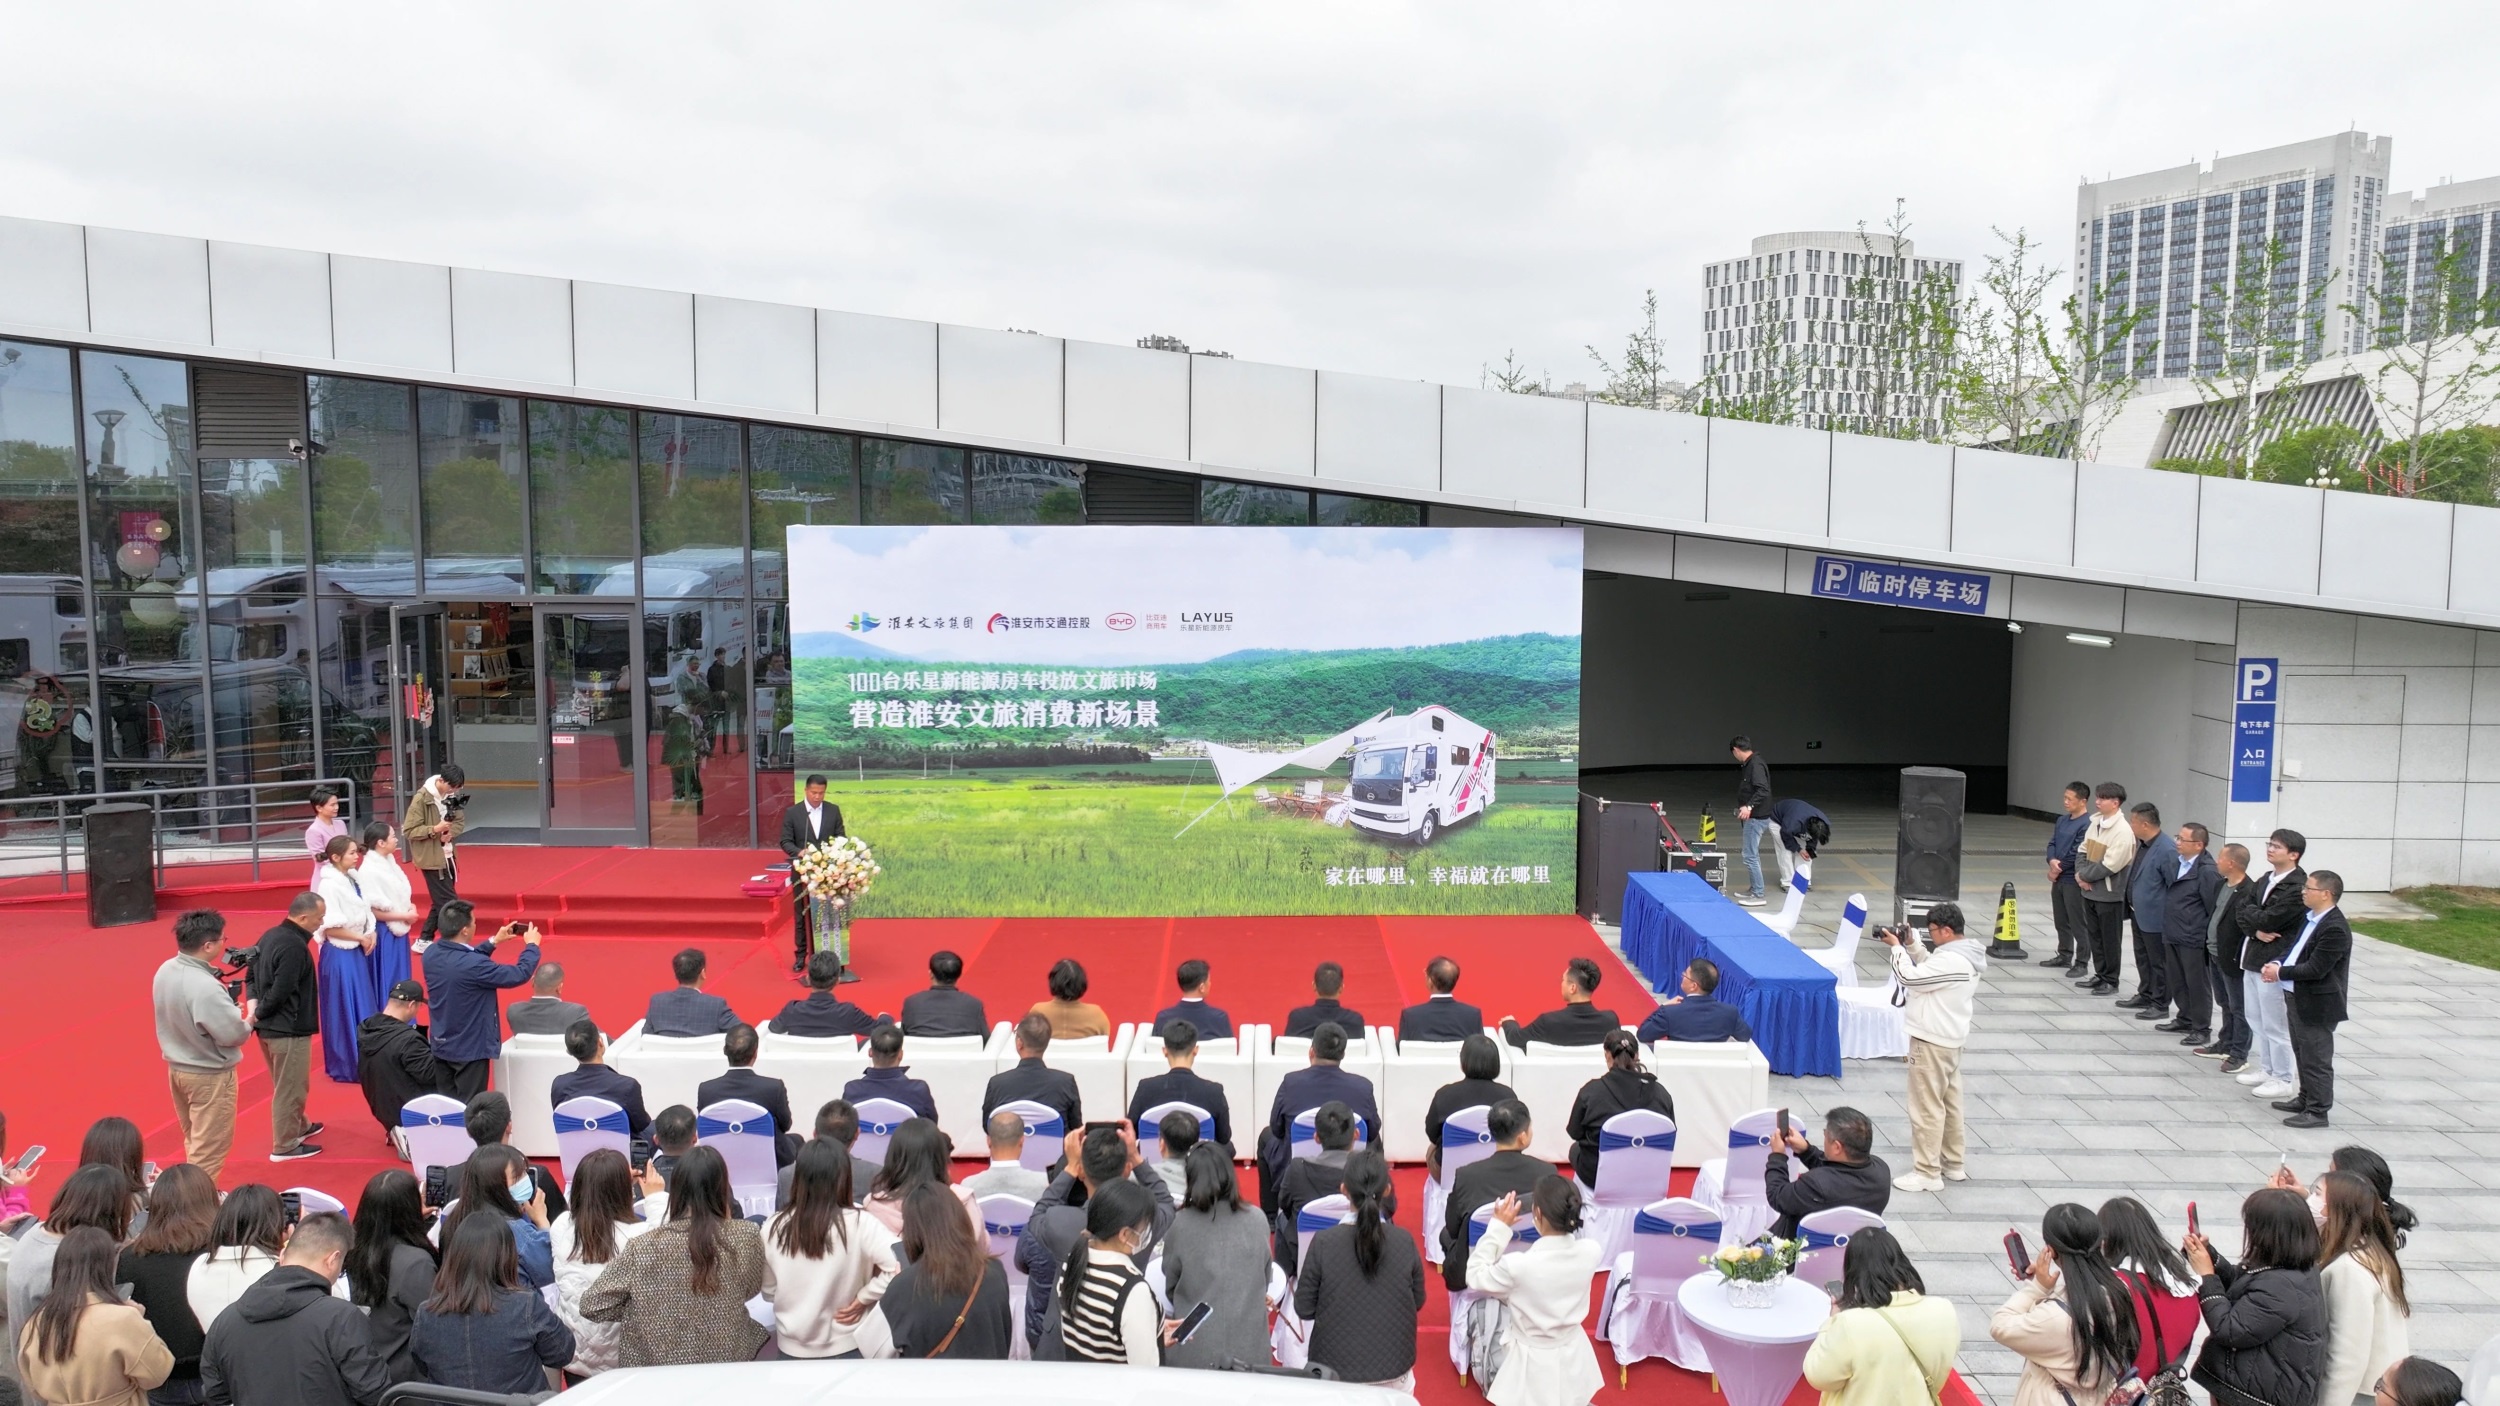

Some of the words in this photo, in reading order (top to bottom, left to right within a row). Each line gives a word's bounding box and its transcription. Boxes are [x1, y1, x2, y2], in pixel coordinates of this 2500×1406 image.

[1858, 570, 1982, 606] 临时停车场
[1011, 617, 1090, 629] 淮安市交通控股
[1109, 618, 1133, 626] BYD
[1181, 612, 1233, 623] LAYUS
[1146, 622, 1168, 630] 商用车
[1180, 624, 1232, 632] 乐星新能源房车
[849, 671, 1157, 692] 100台乐星新能源房车投放文旅市场
[2243, 664, 2272, 700] P
[849, 700, 1160, 729] 营造淮安文旅消费新场景
[2240, 721, 2271, 729] 地下车库
[2243, 748, 2265, 759] 入口
[1325, 866, 1551, 886] 家在哪里，幸福就在哪里
